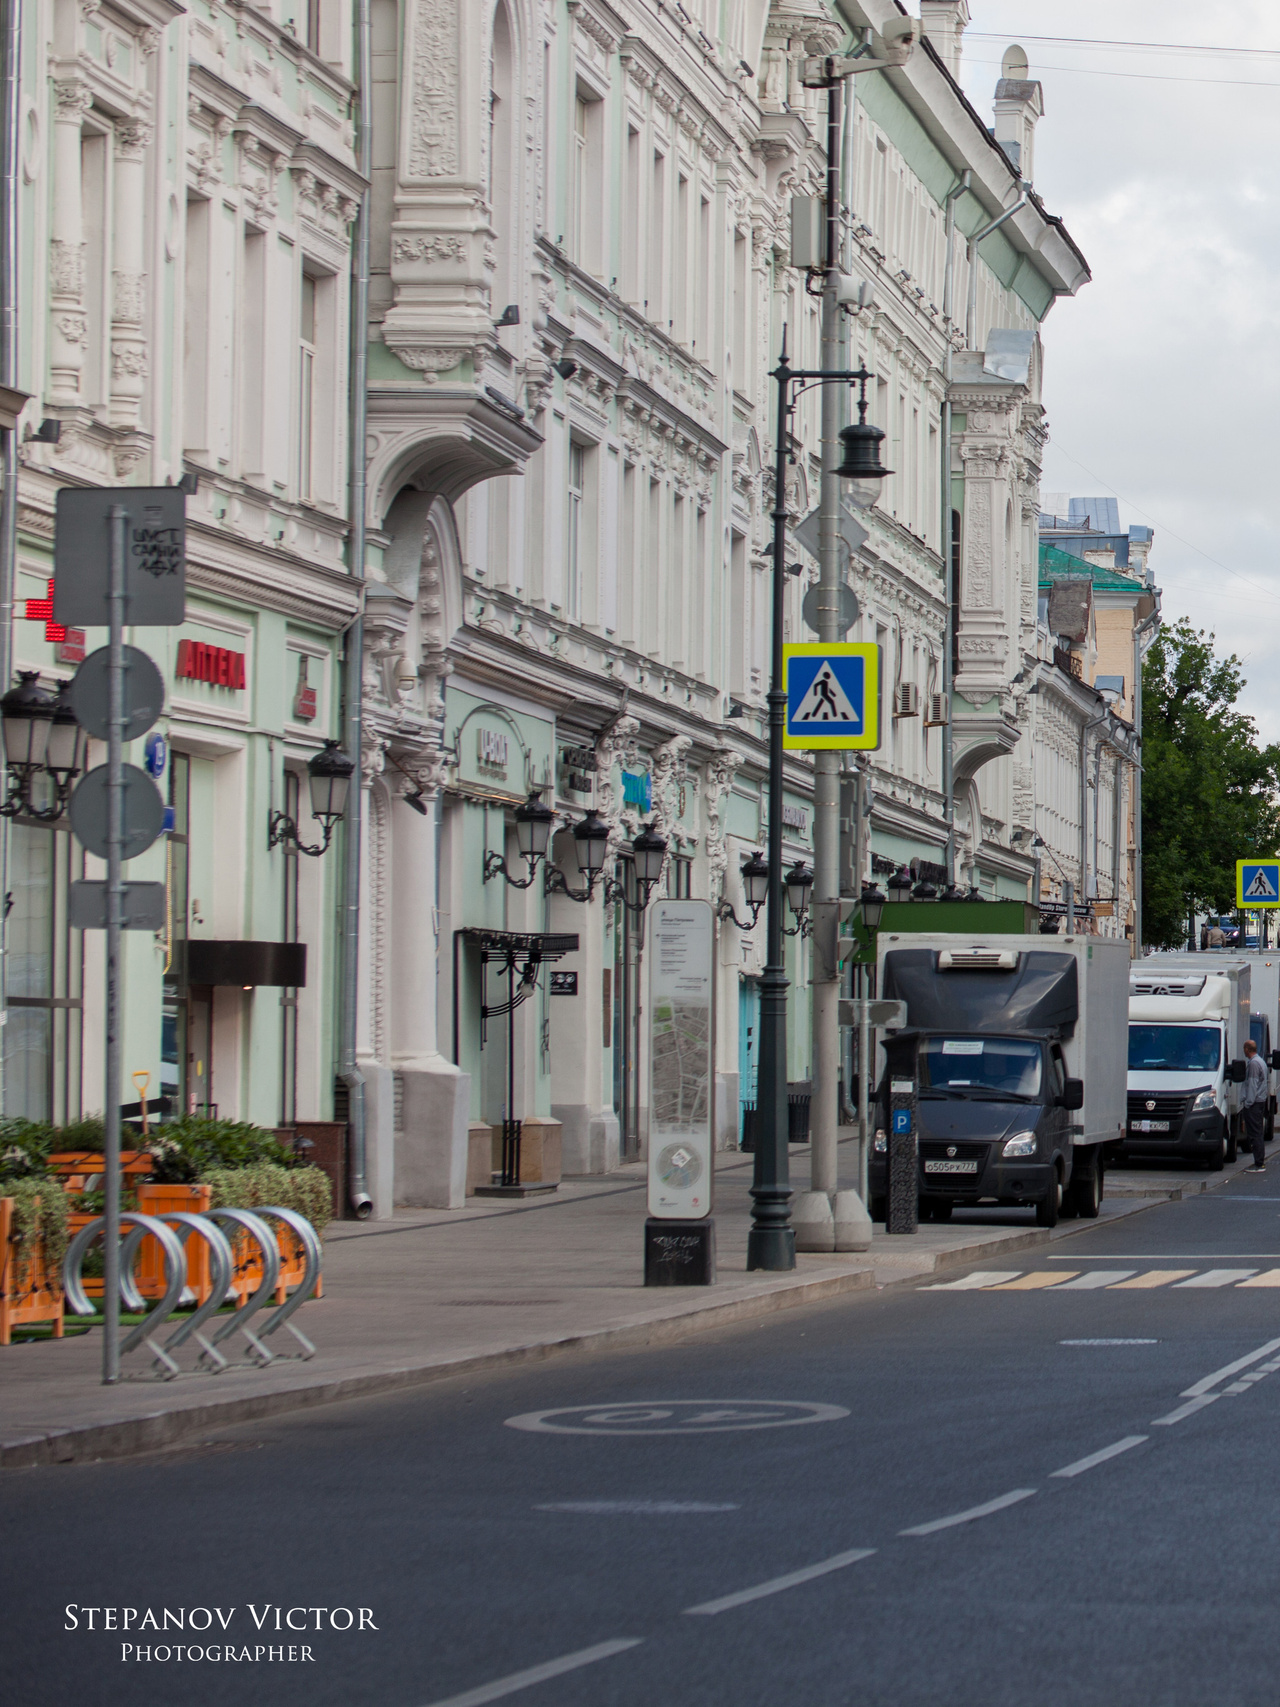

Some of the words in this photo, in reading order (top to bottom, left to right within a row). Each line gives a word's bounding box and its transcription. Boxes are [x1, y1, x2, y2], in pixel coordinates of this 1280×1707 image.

[176, 639, 246, 690] АПТЕКА
[1039, 903, 1055, 911] tandUp
[897, 1115, 908, 1130] P
